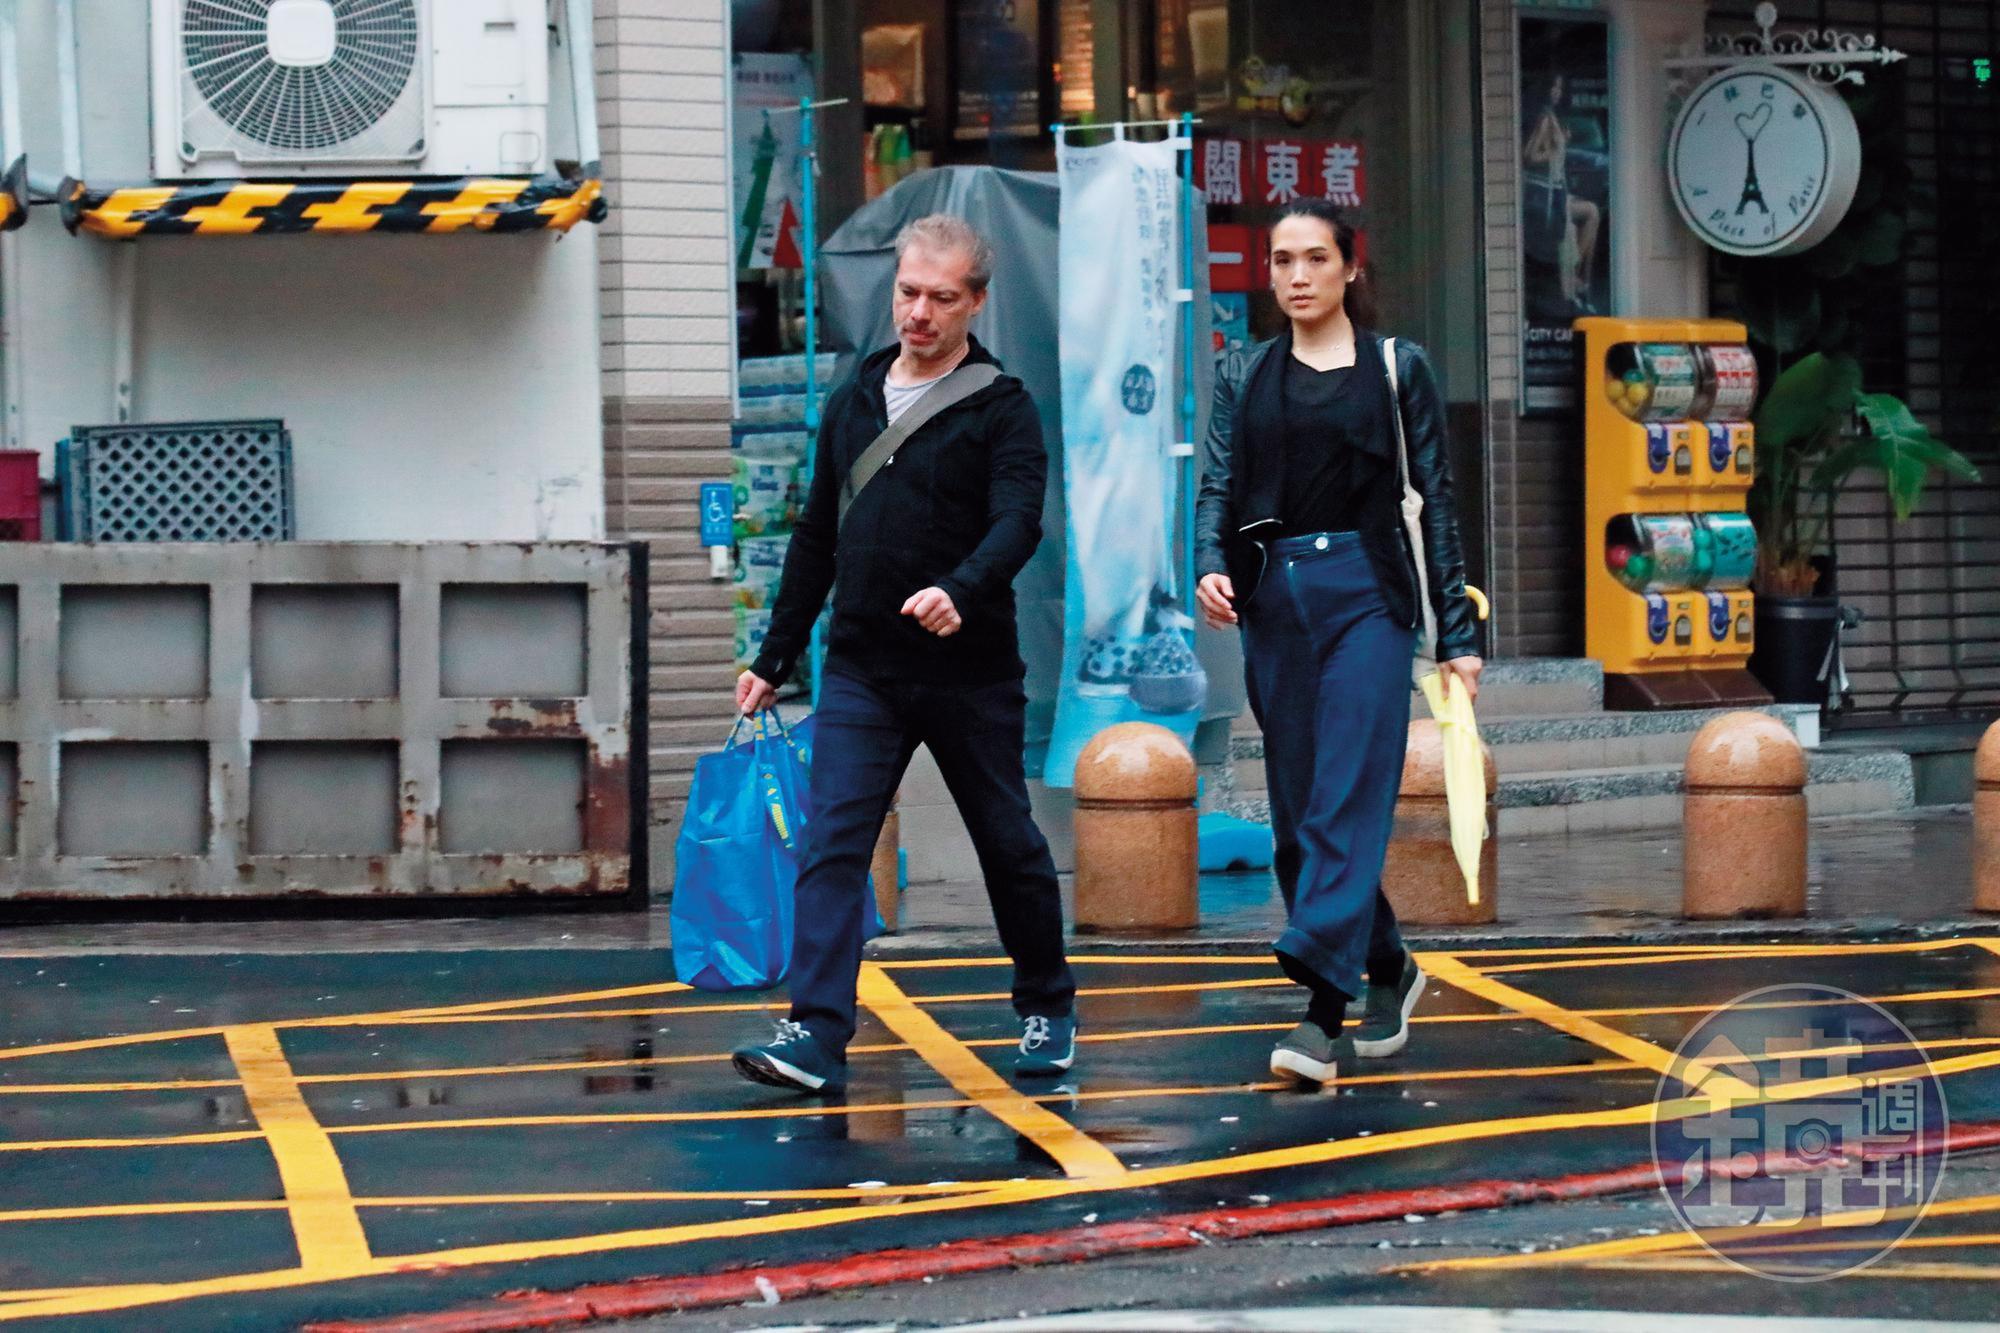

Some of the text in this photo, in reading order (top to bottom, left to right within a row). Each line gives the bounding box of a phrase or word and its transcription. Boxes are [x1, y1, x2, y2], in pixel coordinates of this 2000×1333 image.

[1204, 139, 1361, 206] 關東煮
[1763, 211, 1777, 239] of
[1788, 176, 1815, 216] Paris
